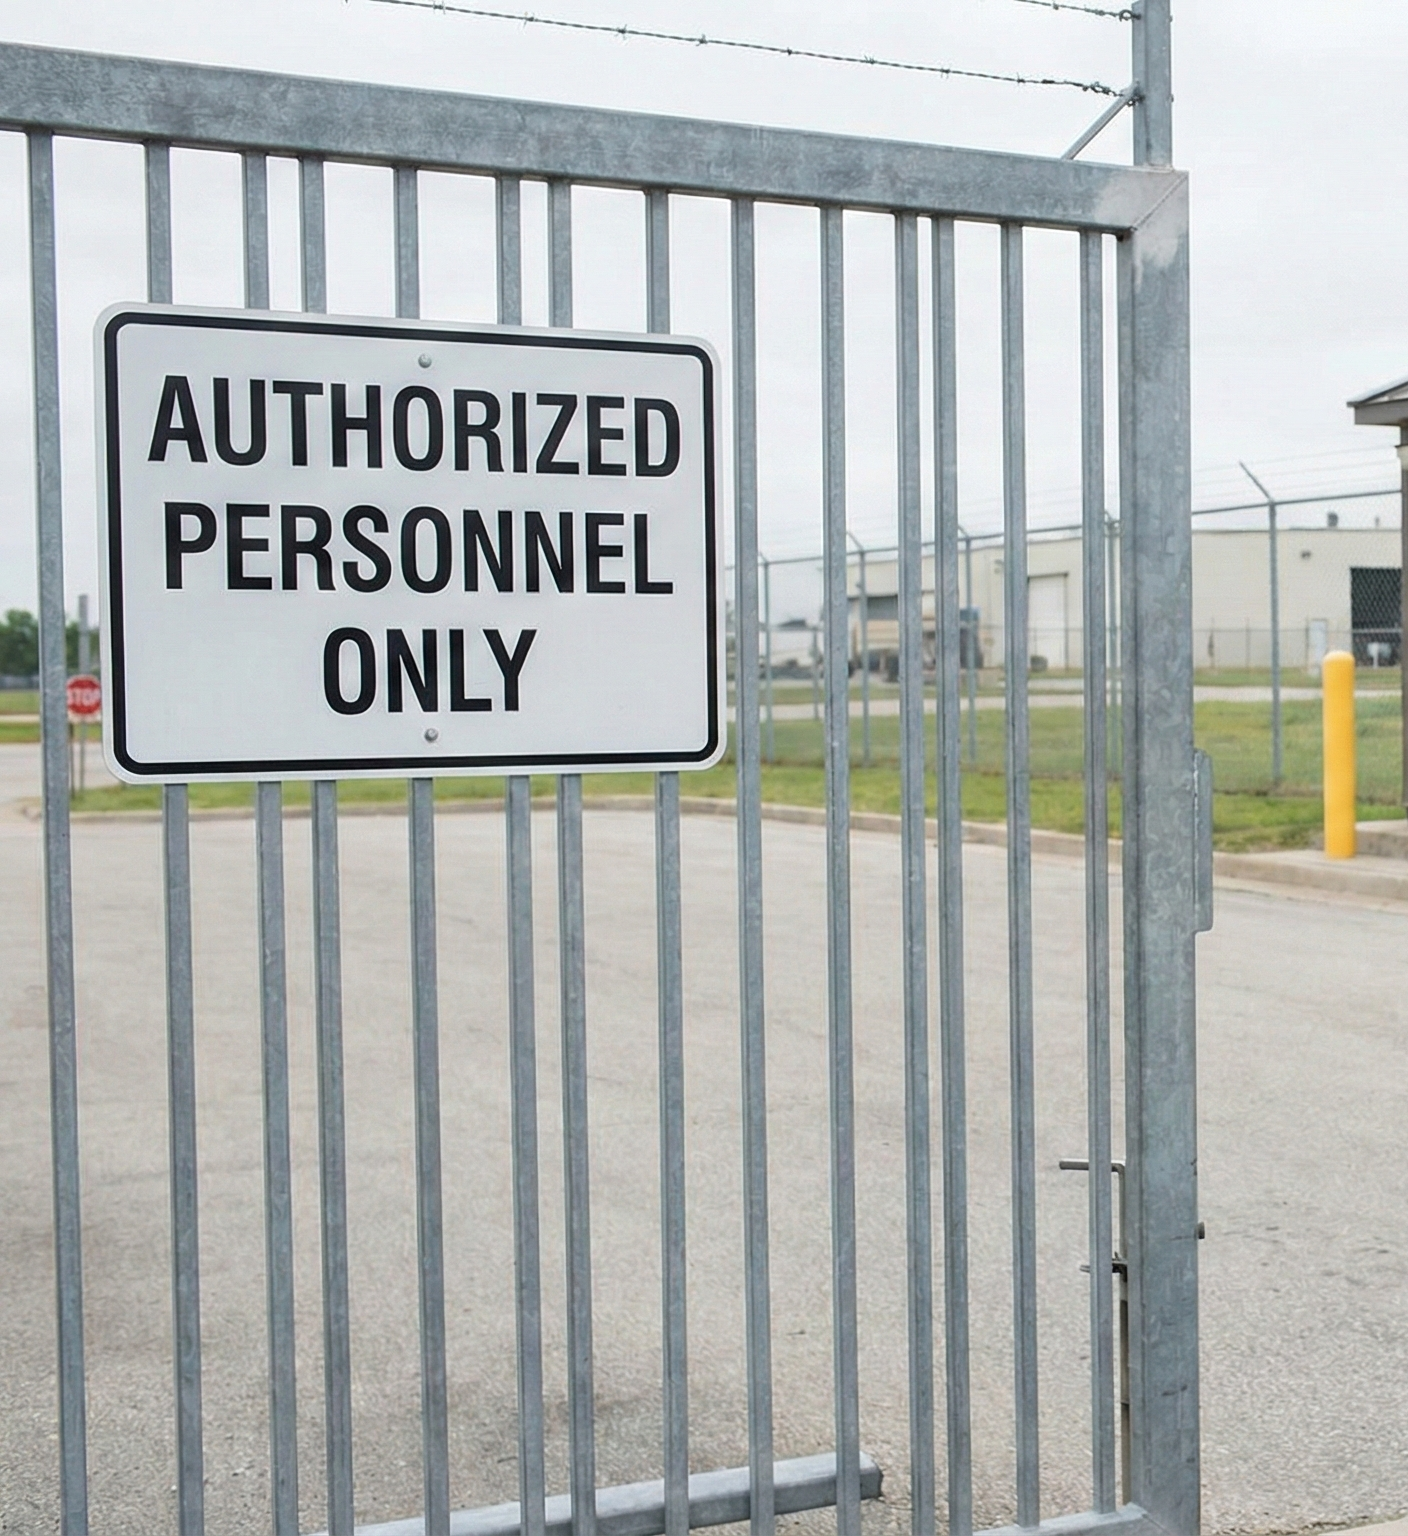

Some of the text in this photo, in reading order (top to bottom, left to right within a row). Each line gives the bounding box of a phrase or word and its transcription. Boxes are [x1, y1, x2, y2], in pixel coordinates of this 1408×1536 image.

[148, 375, 681, 478] AUTHORIZED
[164, 502, 674, 595] PERSONNEL
[323, 627, 537, 716] ONLY
